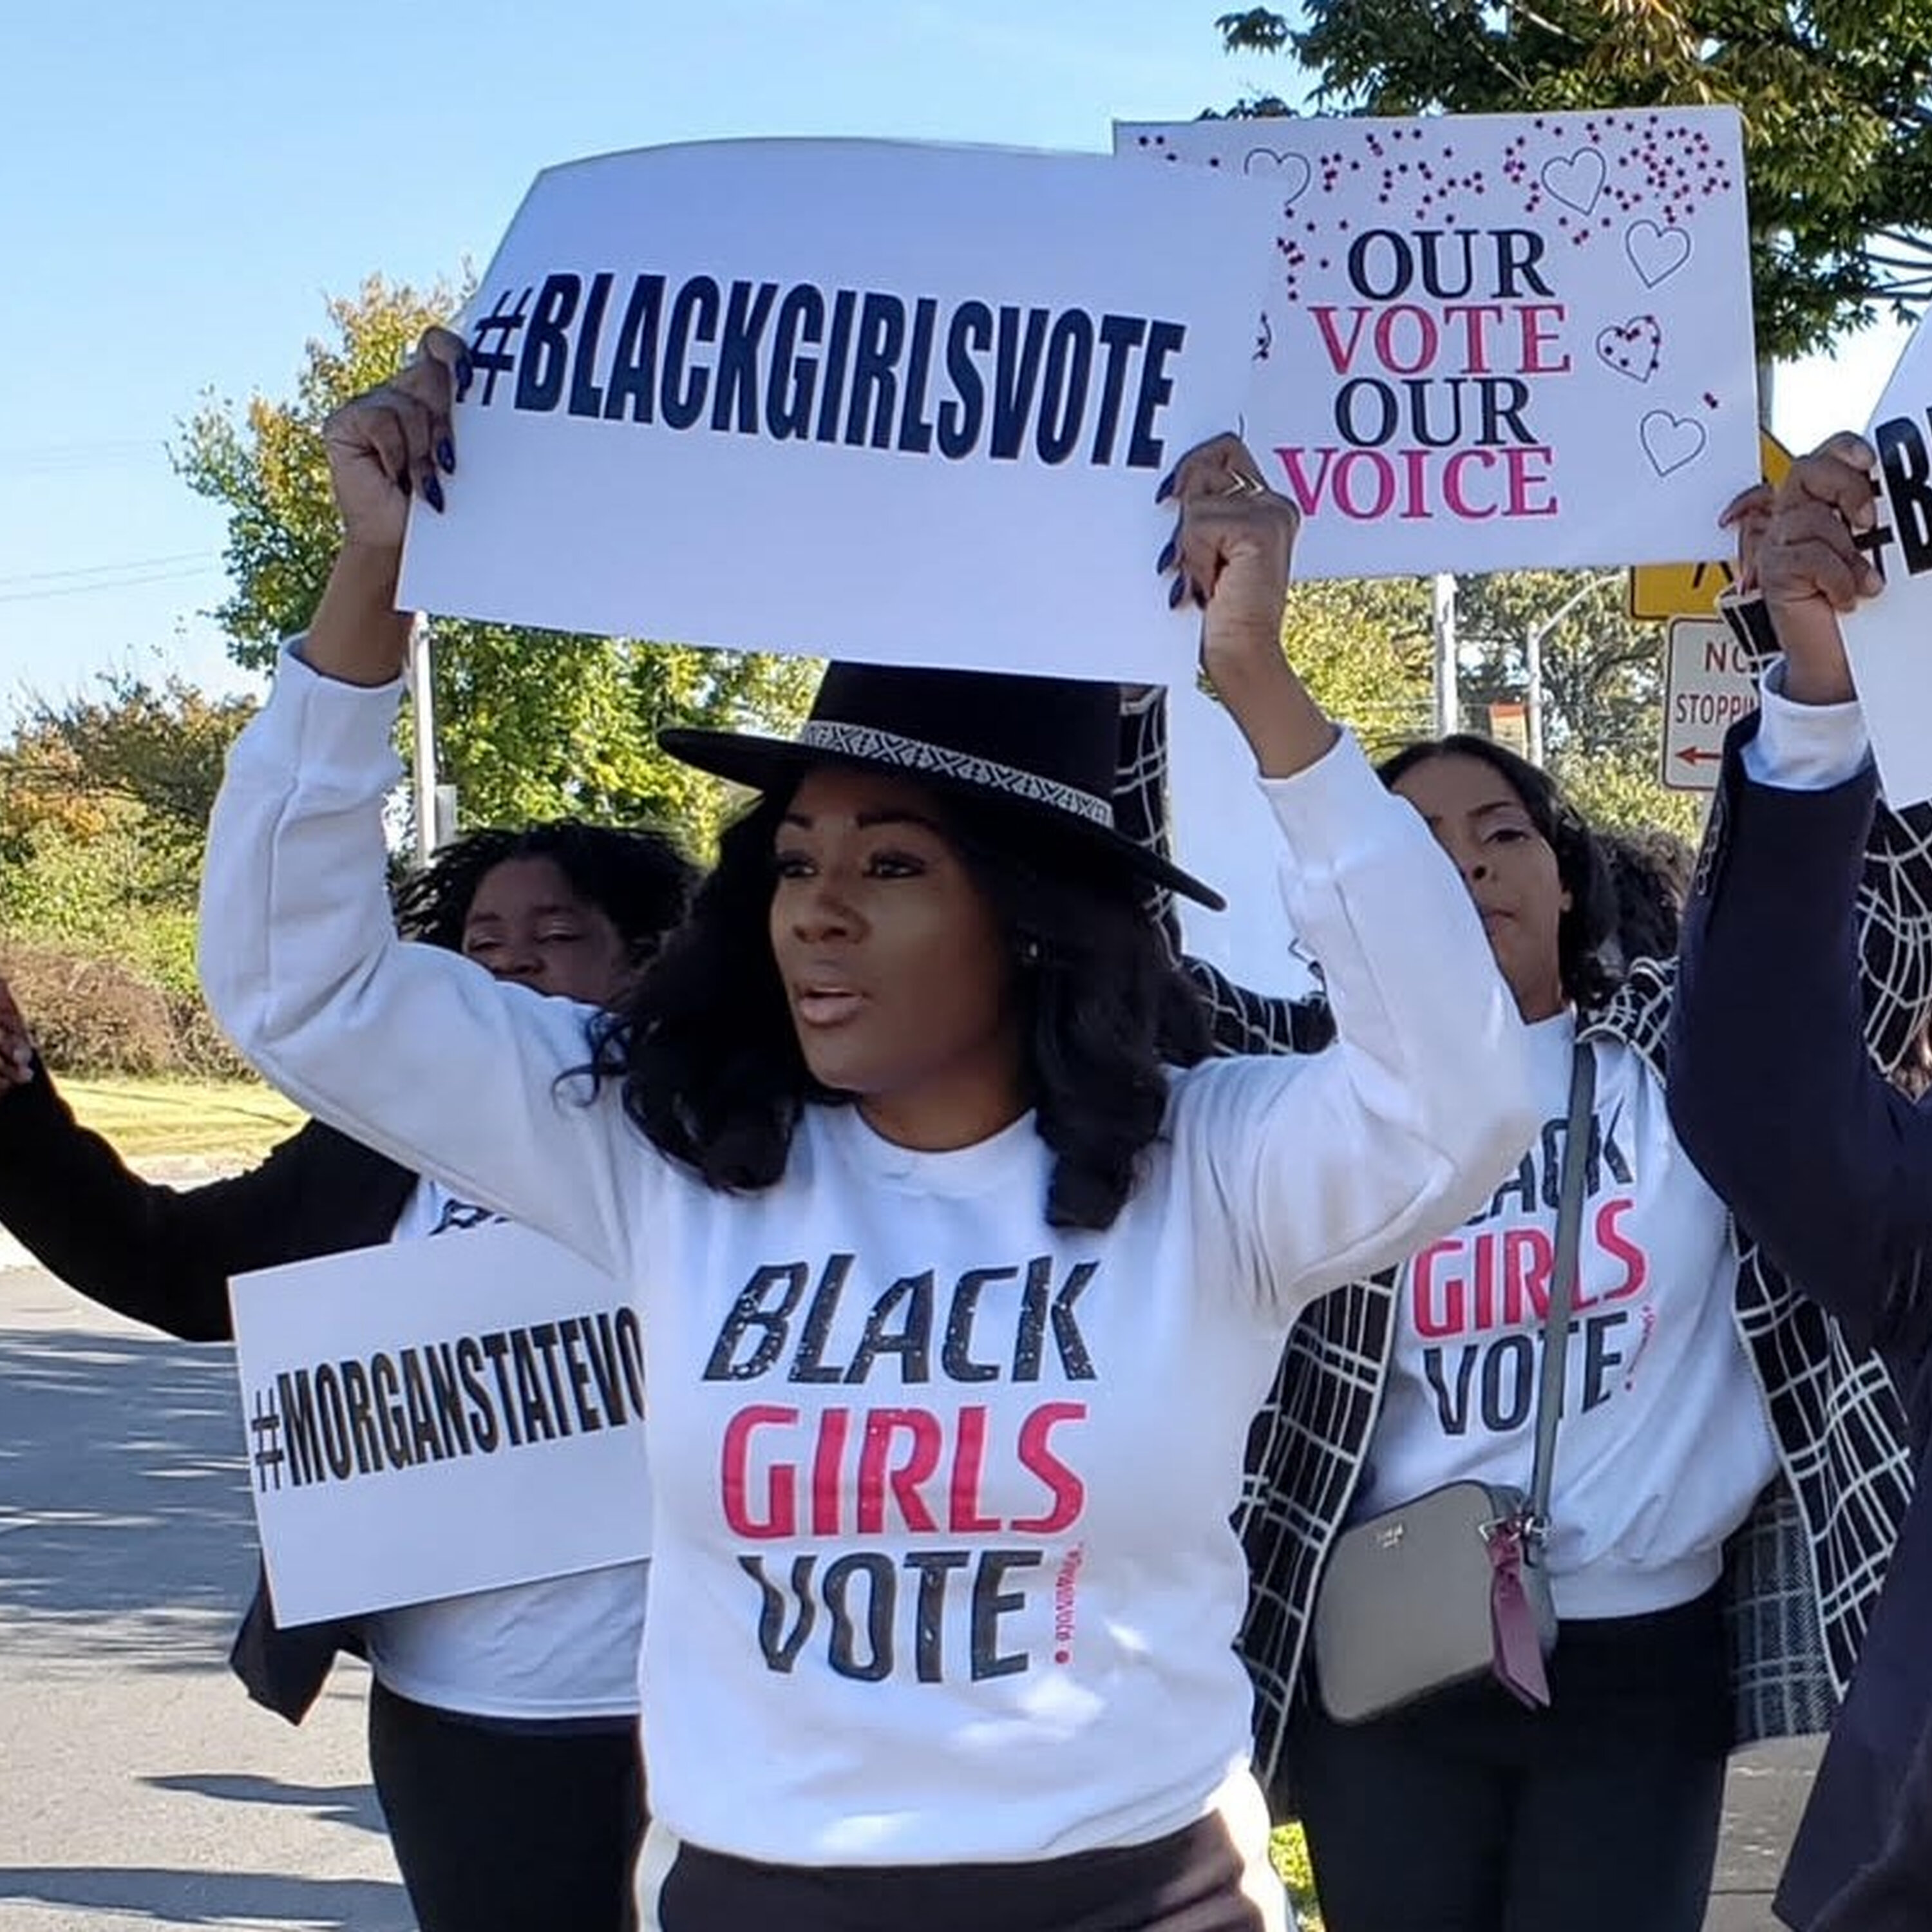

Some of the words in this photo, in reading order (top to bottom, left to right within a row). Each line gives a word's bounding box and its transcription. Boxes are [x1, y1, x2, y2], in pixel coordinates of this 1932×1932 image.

[1347, 228, 1555, 301] OUR
[456, 272, 1186, 469] #BLACKGIRLSVOTE
[1307, 303, 1572, 375] VOTE
[1334, 376, 1539, 448] OUR
[1273, 446, 1559, 520] VOICE
[1676, 694, 1755, 725] STOPPI
[701, 1253, 1101, 1385] BLACK
[252, 1307, 645, 1493] #MORGANSTATEVO
[721, 1402, 1087, 1539] GIRLS
